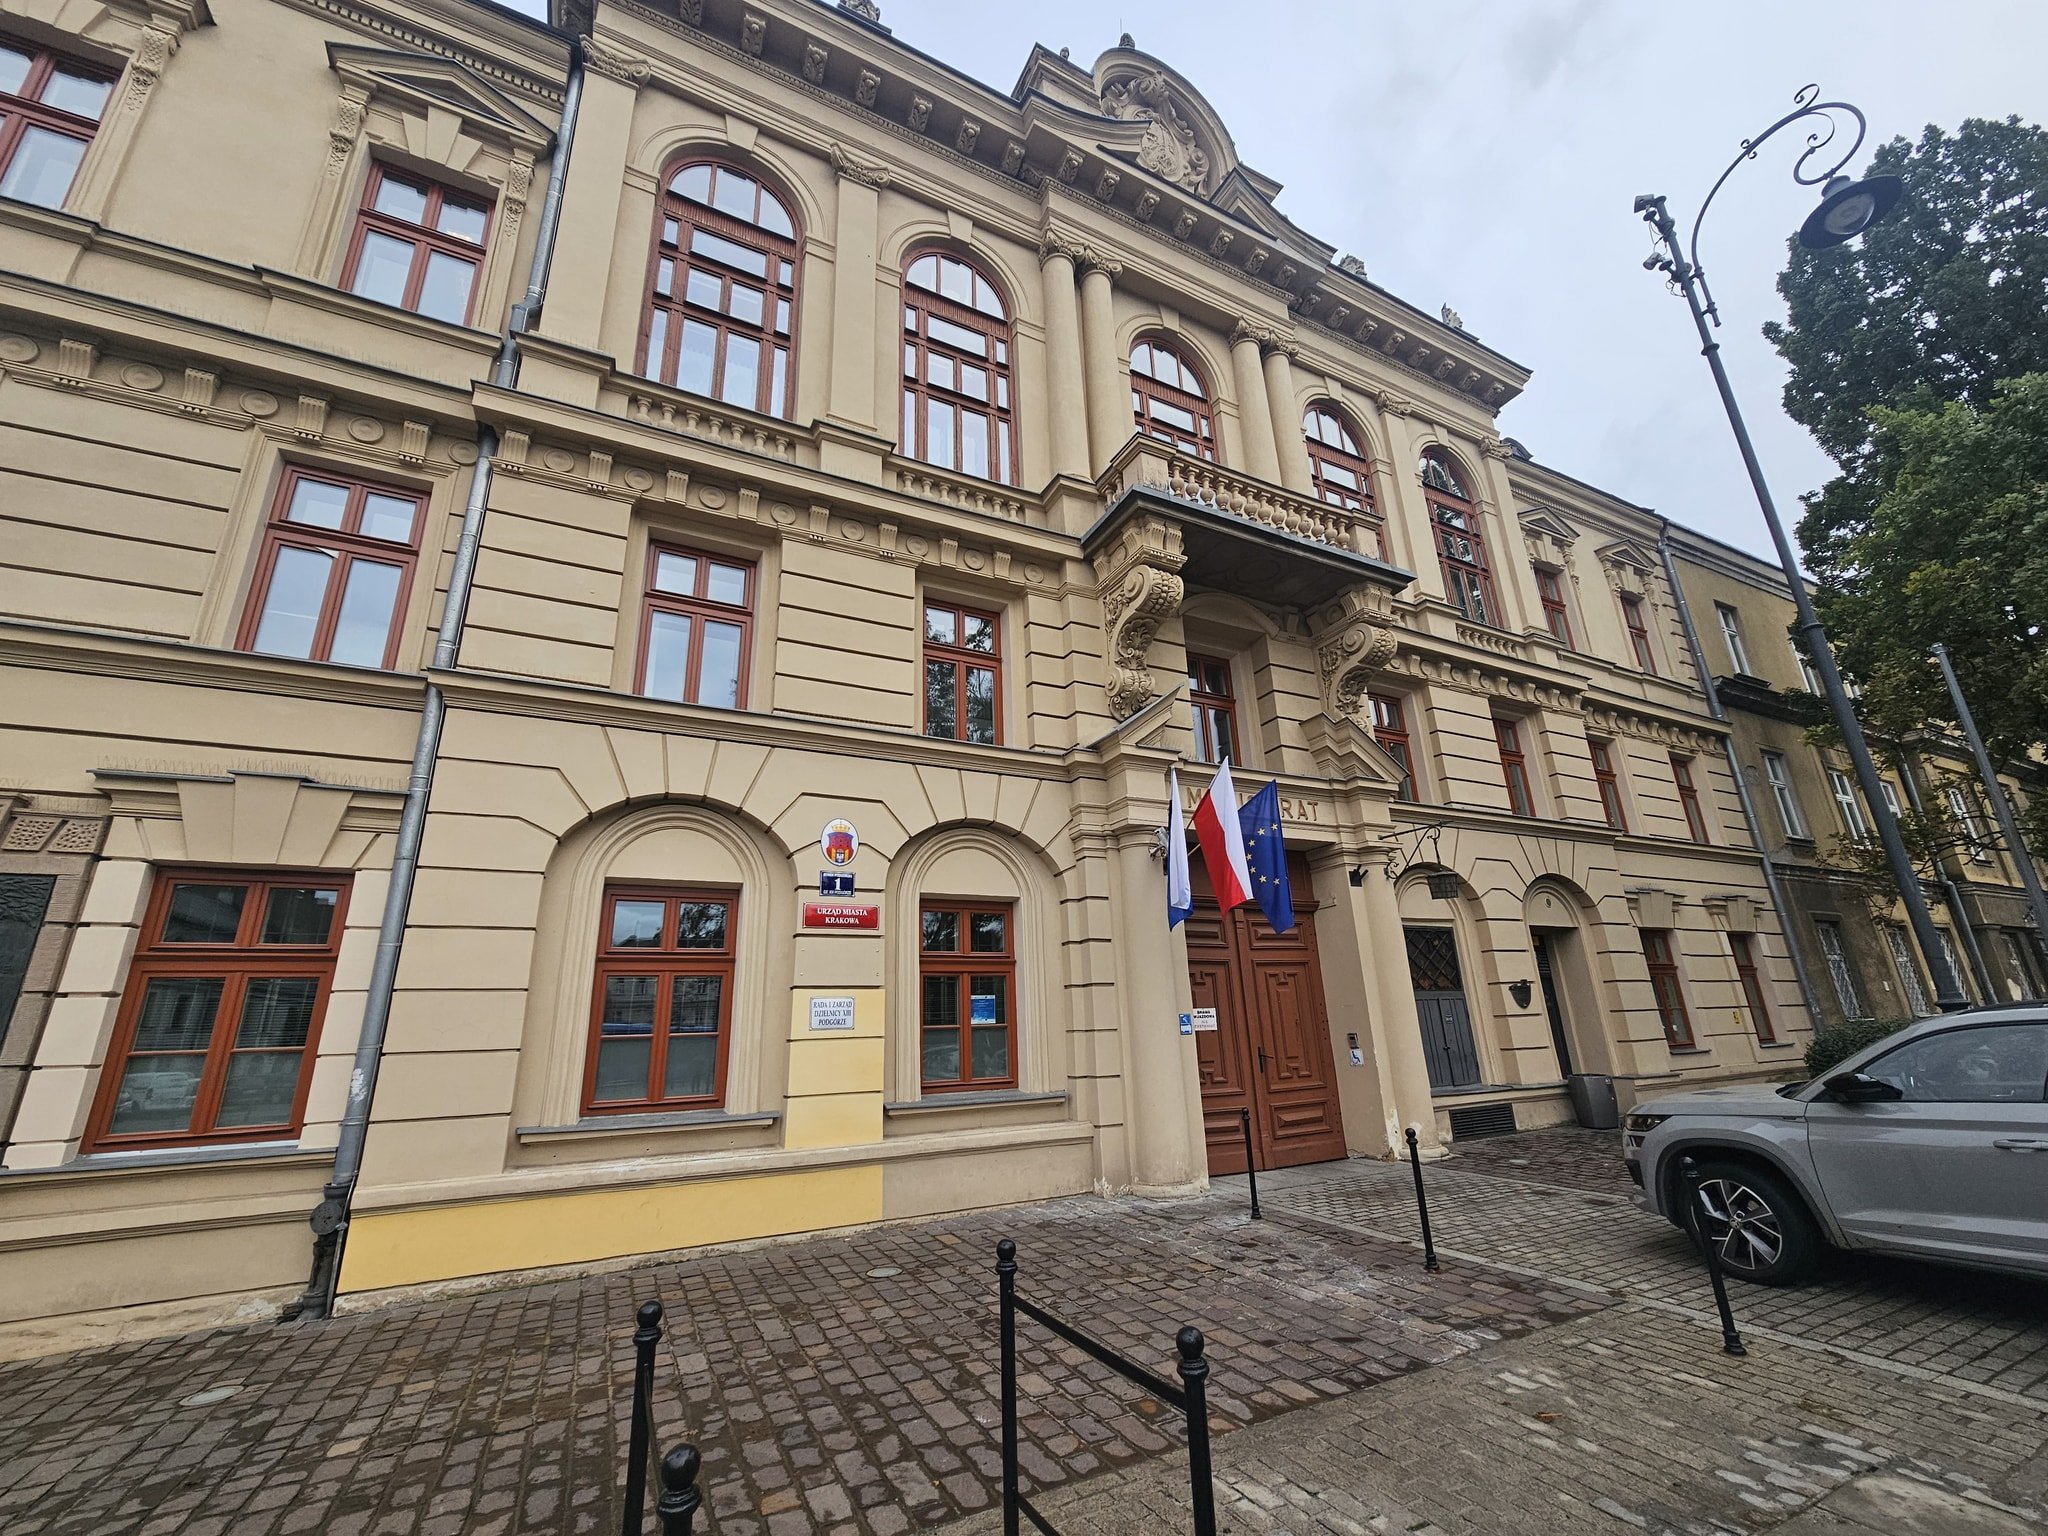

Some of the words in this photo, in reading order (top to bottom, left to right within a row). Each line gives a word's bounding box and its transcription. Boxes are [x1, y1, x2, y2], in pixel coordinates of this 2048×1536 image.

[1186, 787, 1319, 822] MIRAT
[834, 877, 841, 891] 1
[817, 907, 841, 917] URZĄD
[842, 908, 868, 916] MIASTA
[825, 916, 859, 924] KRAKOWA
[814, 1009, 841, 1017] DZIELNICY
[818, 1017, 847, 1026] PODGÓRZE
